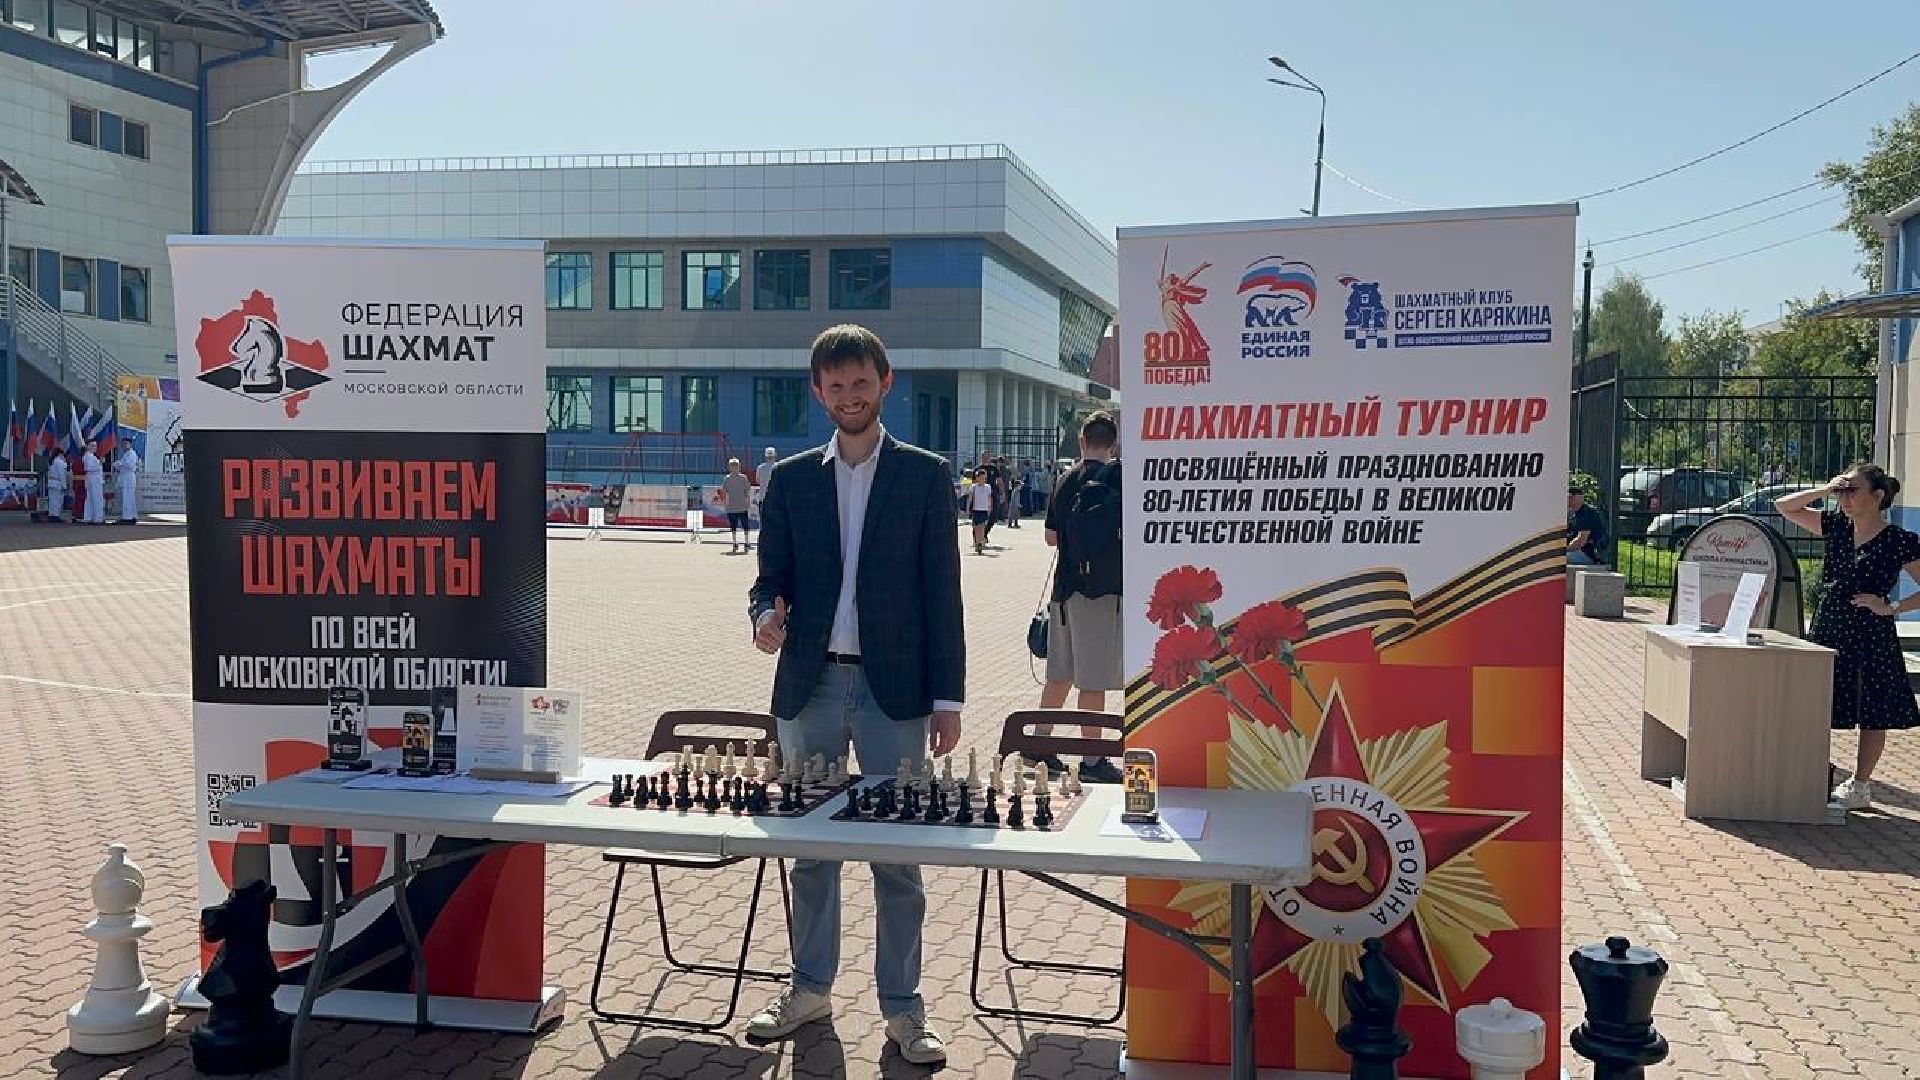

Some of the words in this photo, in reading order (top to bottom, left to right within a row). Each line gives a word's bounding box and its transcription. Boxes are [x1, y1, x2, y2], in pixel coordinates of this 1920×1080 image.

[1395, 289, 1476, 308] ШАХМАТНЫЙ
[1479, 290, 1513, 305] КЛУБ
[342, 303, 523, 331] ФЕДЕРАЦИЯ
[1394, 308, 1456, 330] СЕРГЕЯ
[1460, 305, 1552, 328] КАРЯКИНА
[342, 334, 495, 362] ШАХМАТ
[1144, 331, 1180, 361] 80
[1241, 330, 1310, 346] ЕДИНАЯ
[1241, 344, 1310, 359] РОССИЯ
[344, 382, 448, 395] МОСКОВСКОЙ
[455, 383, 524, 396] ОБЛАСТИ
[1144, 367, 1211, 386] ПОБЕДА!
[1141, 396, 1381, 441] ШАХМАТНЫЙ
[1397, 398, 1547, 436] ТУРНИР
[1143, 450, 1328, 484] ПОСВЯЩЁННЫЙ
[1337, 452, 1544, 482] ПРАЗДНОВАНИЮ
[222, 459, 496, 520] РАЗВИВАЕМ
[1143, 487, 1253, 513] 80-ЛЕТИЯ
[1261, 487, 1364, 515] ПОБЕДЫ
[1372, 488, 1390, 511] В
[1398, 482, 1516, 511] ВЕЛИКОЙ
[1144, 515, 1333, 544] ОТЕЧЕСТВЕННОЙ
[1341, 515, 1424, 544] ВОЙНЕ
[241, 535, 480, 596] ШАХМАТЫ
[311, 615, 344, 649] ПО
[353, 612, 416, 649] ВСЕЙ
[218, 653, 386, 689] МОСКОВСКОЙ
[393, 657, 507, 690] ОБЛАСТИ!
[1370, 839, 1419, 925] ВОЙНА
